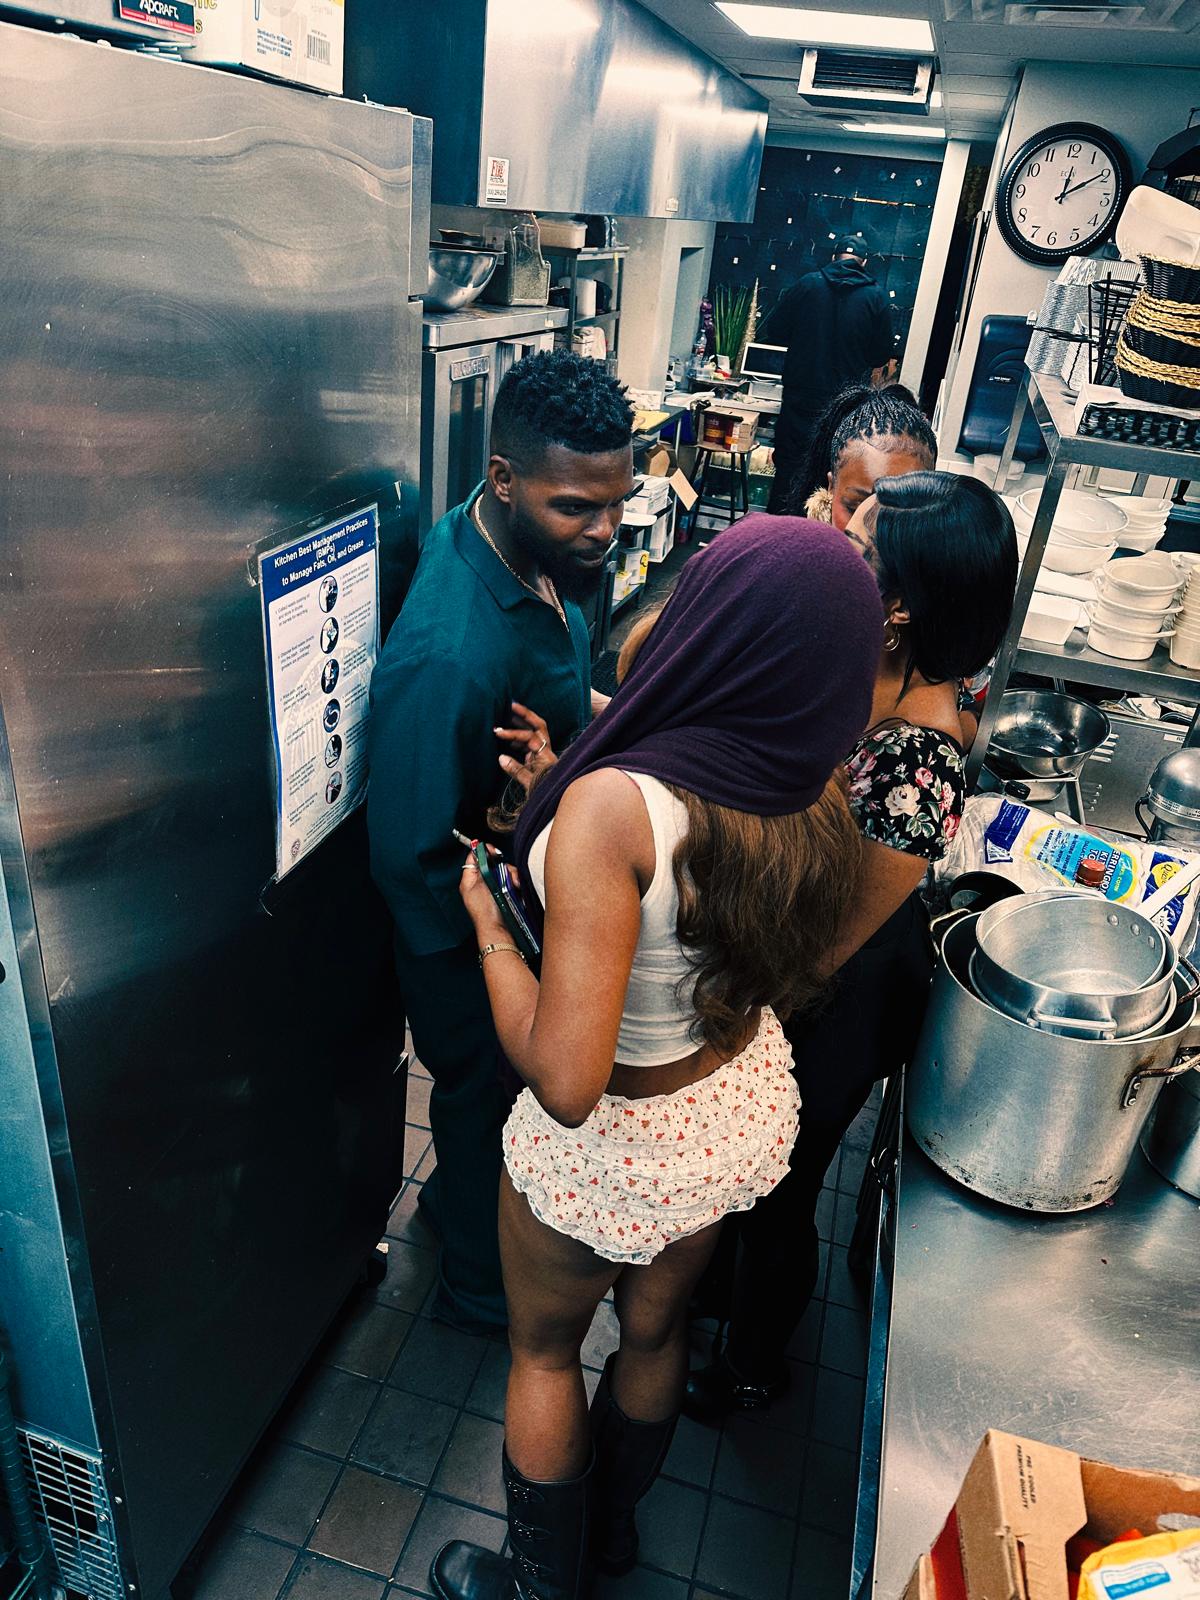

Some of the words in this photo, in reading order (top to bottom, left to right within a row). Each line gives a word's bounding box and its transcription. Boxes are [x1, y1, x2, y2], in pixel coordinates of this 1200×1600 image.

[1045, 148, 1055, 162] 11
[1067, 144, 1082, 158] 12
[1091, 151, 1097, 164] 1
[1027, 163, 1040, 177] 10
[1100, 168, 1111, 183] 2
[1016, 184, 1026, 199] 9
[1100, 193, 1110, 207] 3
[1017, 208, 1027, 223] 8
[1088, 213, 1098, 226] 4
[1031, 225, 1041, 238] 7
[1047, 232, 1057, 245] 6
[1070, 228, 1080, 241] 5
[274, 551, 298, 568] Kitchen
[298, 543, 312, 555] Best
[312, 528, 345, 549] Management
[346, 518, 368, 534] Practices
[316, 543, 336, 560] (BMPs)
[281, 577, 288, 586] to
[289, 566, 313, 583] Manage
[313, 559, 327, 571] Fats,
[337, 548, 347, 559] and
[347, 540, 364, 552] Grease
[1016, 1444, 1025, 1477] PREMIUM
[1020, 1478, 1029, 1509] QUALITY
